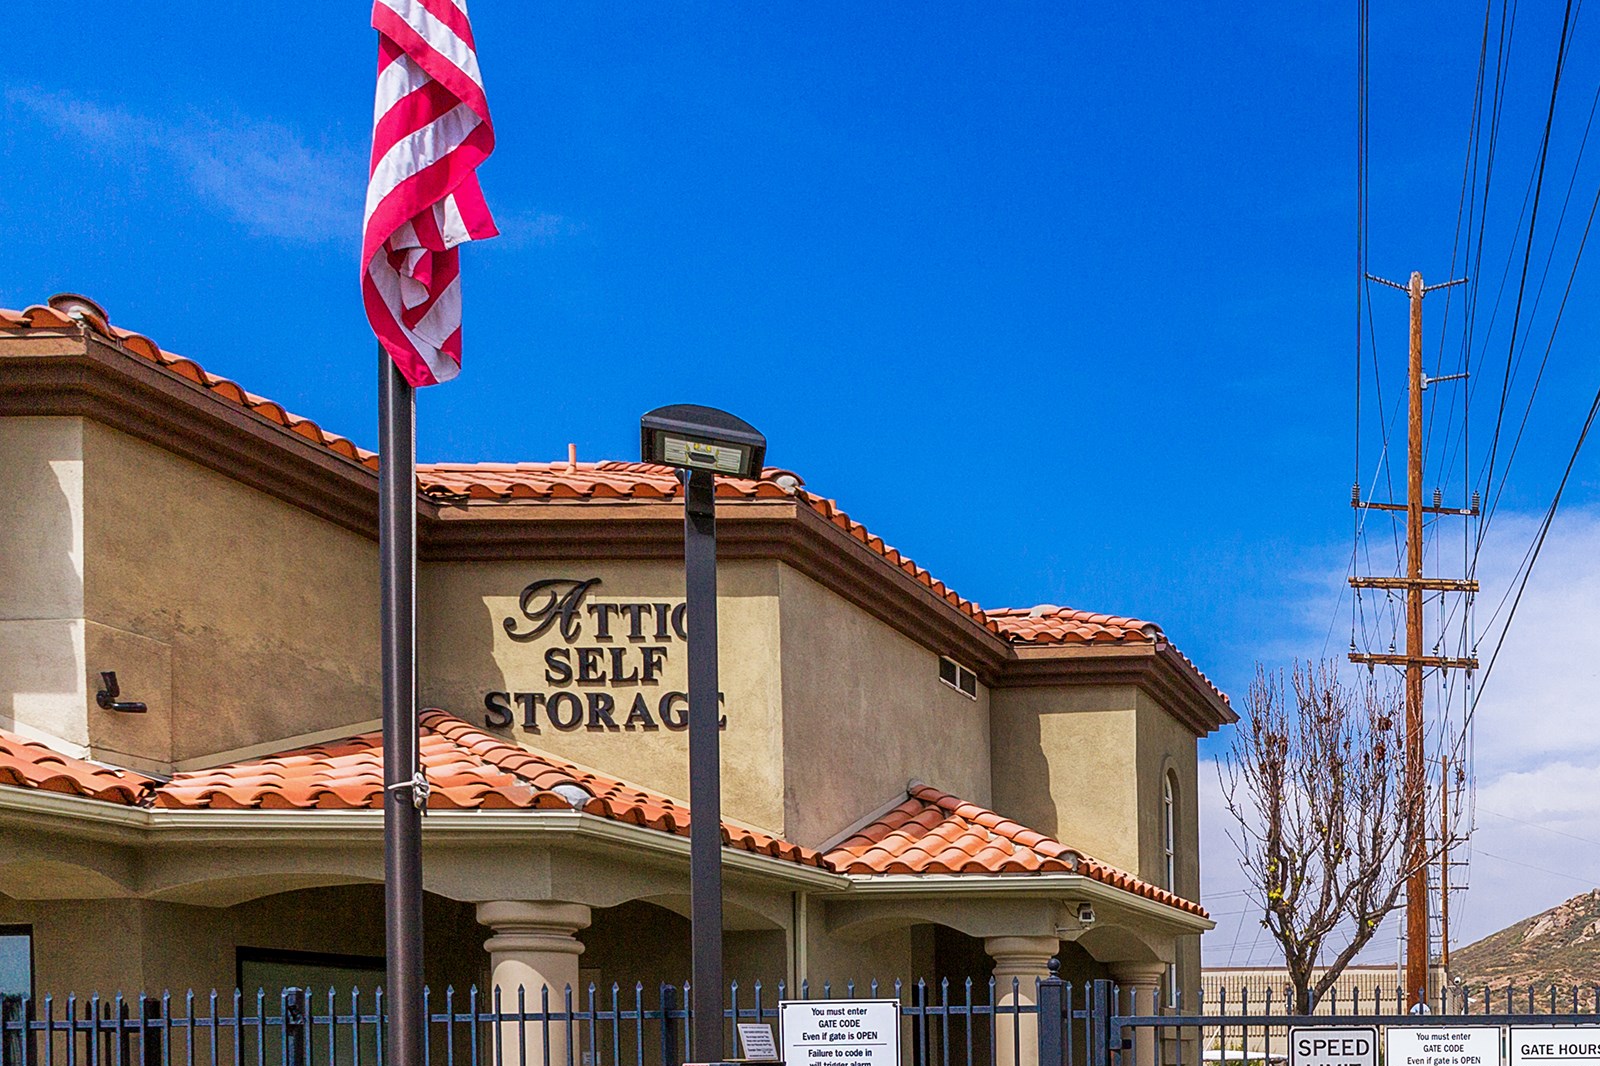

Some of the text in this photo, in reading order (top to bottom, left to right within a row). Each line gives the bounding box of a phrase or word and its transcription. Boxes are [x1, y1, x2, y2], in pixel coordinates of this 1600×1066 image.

[545, 646, 667, 685] SELF
[818, 1020, 837, 1028] GATE
[802, 1032, 878, 1042] Even if gate is OPEN
[1298, 1039, 1369, 1056] SPEED
[1521, 1044, 1554, 1055] GATE
[808, 1049, 833, 1057] Failure
[845, 1049, 863, 1057] code
[1434, 1057, 1450, 1066] gate
